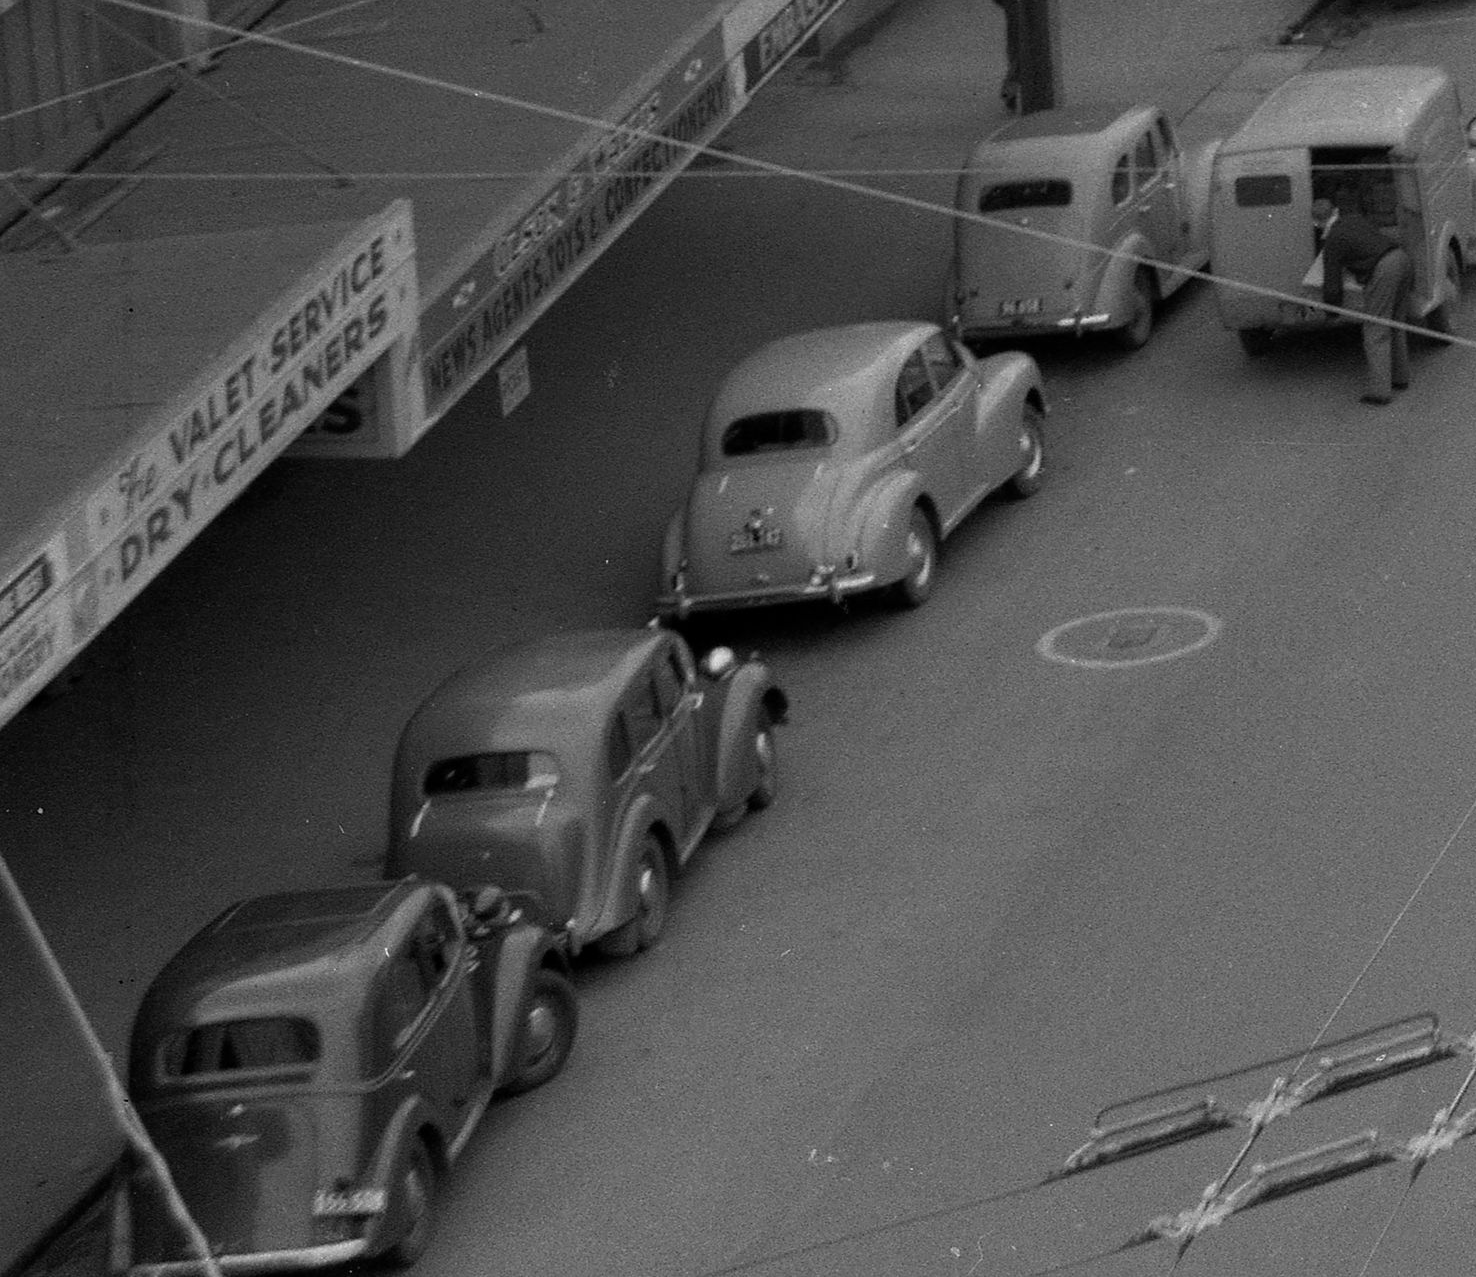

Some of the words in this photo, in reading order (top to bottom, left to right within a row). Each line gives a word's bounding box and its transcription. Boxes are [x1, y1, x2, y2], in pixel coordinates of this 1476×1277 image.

[119, 472, 198, 584] DRY
[212, 290, 391, 487] CLEANERS
[168, 356, 260, 466] VALET
[269, 235, 387, 378] SERVICE
